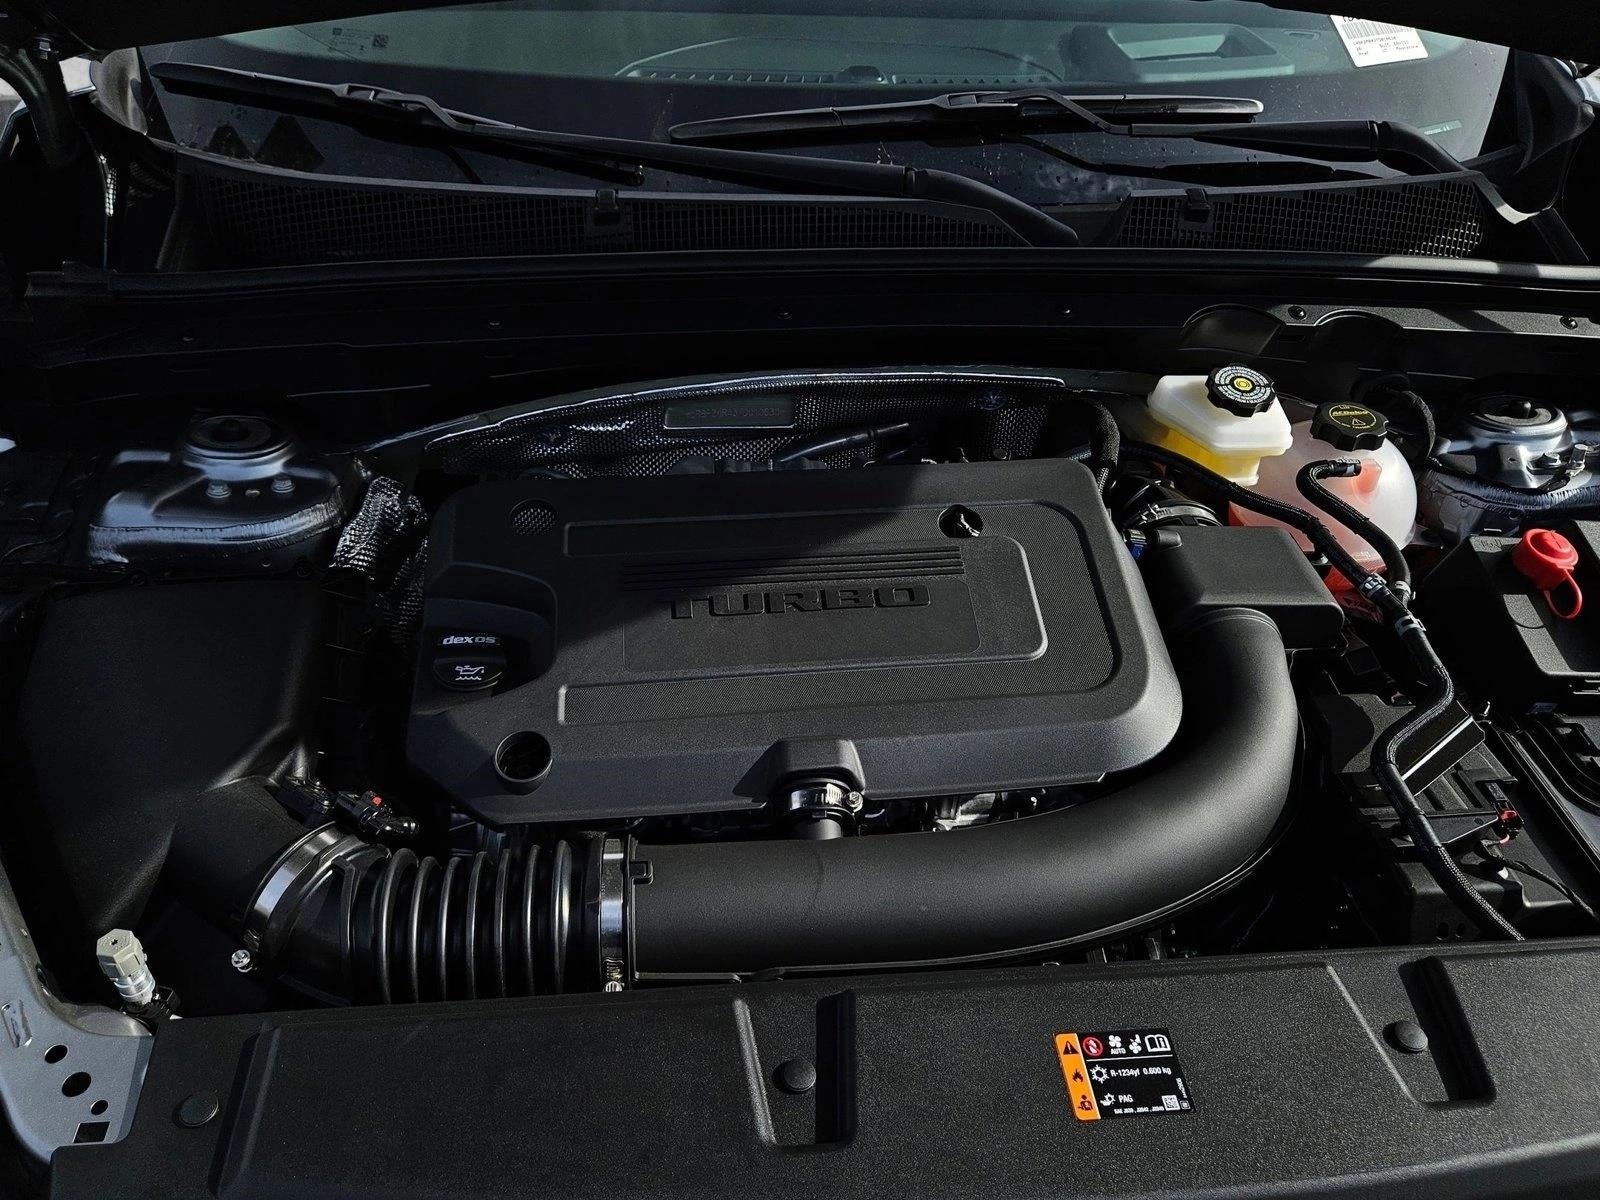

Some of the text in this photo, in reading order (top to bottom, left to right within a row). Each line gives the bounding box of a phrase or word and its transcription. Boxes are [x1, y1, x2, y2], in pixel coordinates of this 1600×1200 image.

[655, 585, 931, 620] TURBO
[442, 635, 496, 645] dexos
[1110, 1047, 1127, 1055] AUTO
[1110, 1066, 1172, 1077] R-1234yf 0.600 kg
[1119, 1094, 1134, 1103] PAG
